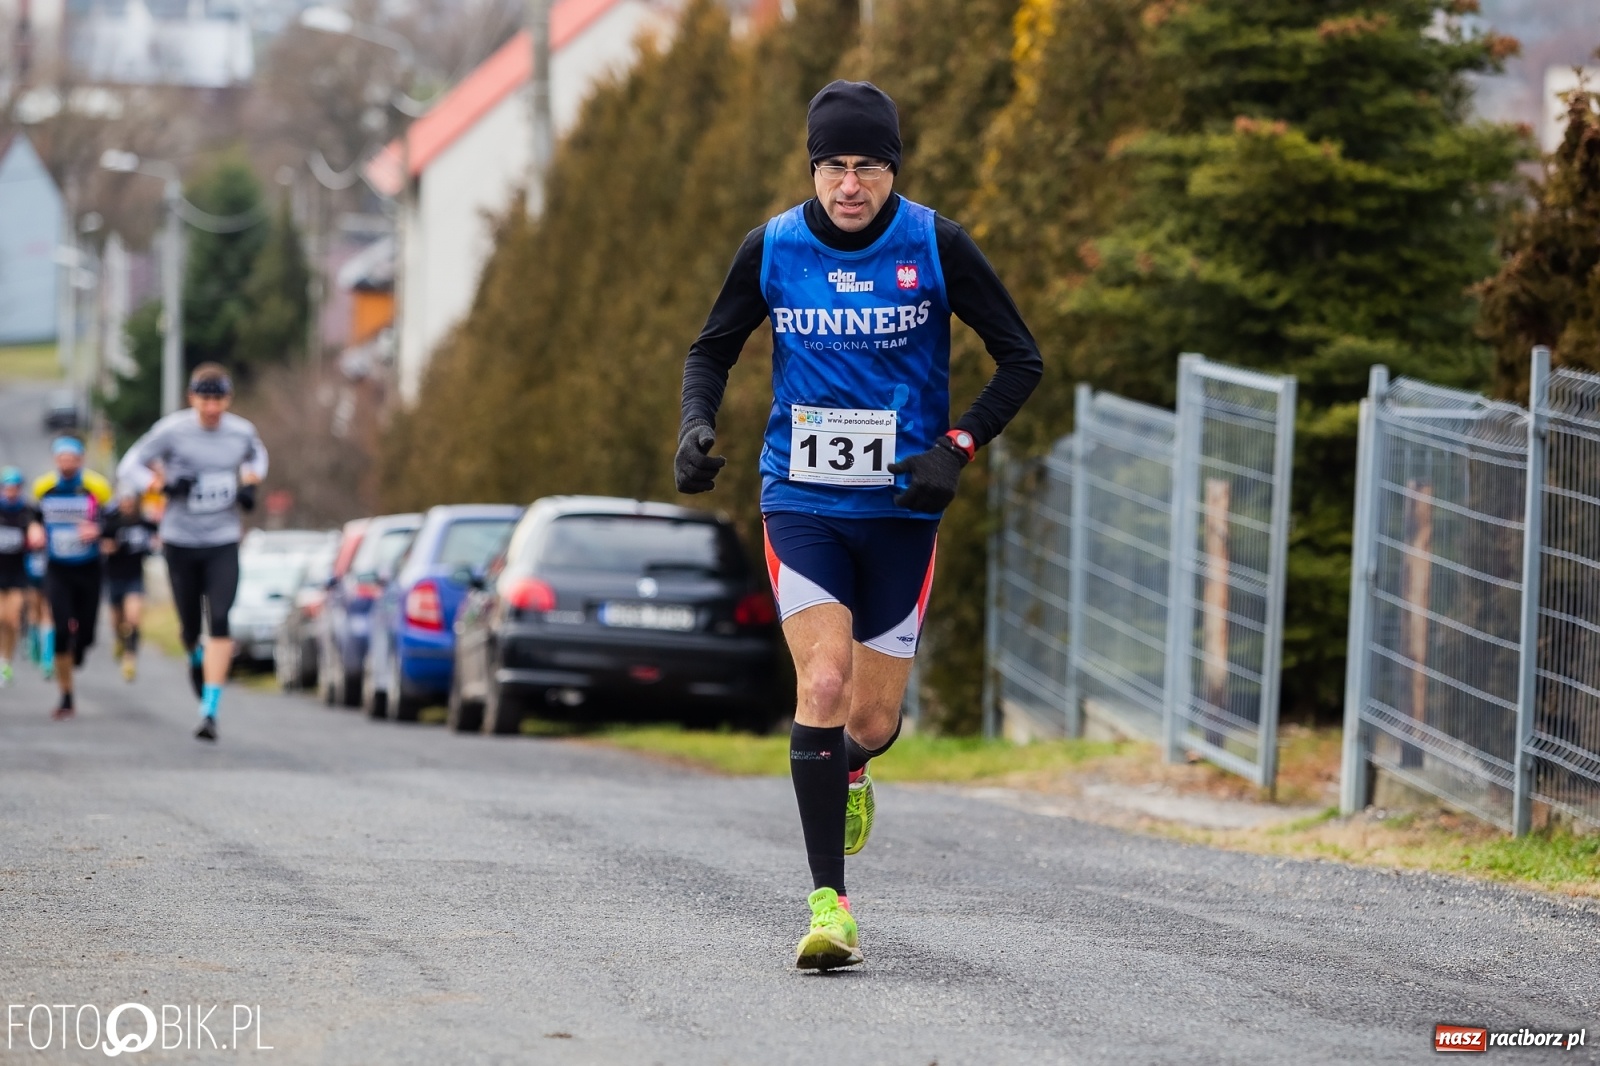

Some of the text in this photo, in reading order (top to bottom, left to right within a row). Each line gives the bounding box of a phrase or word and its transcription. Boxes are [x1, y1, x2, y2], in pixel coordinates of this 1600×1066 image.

[773, 300, 932, 335] RUNNERS
[873, 337, 908, 349] TEAM
[827, 417, 892, 426] www.personalbest.pl
[800, 434, 883, 471] 131
